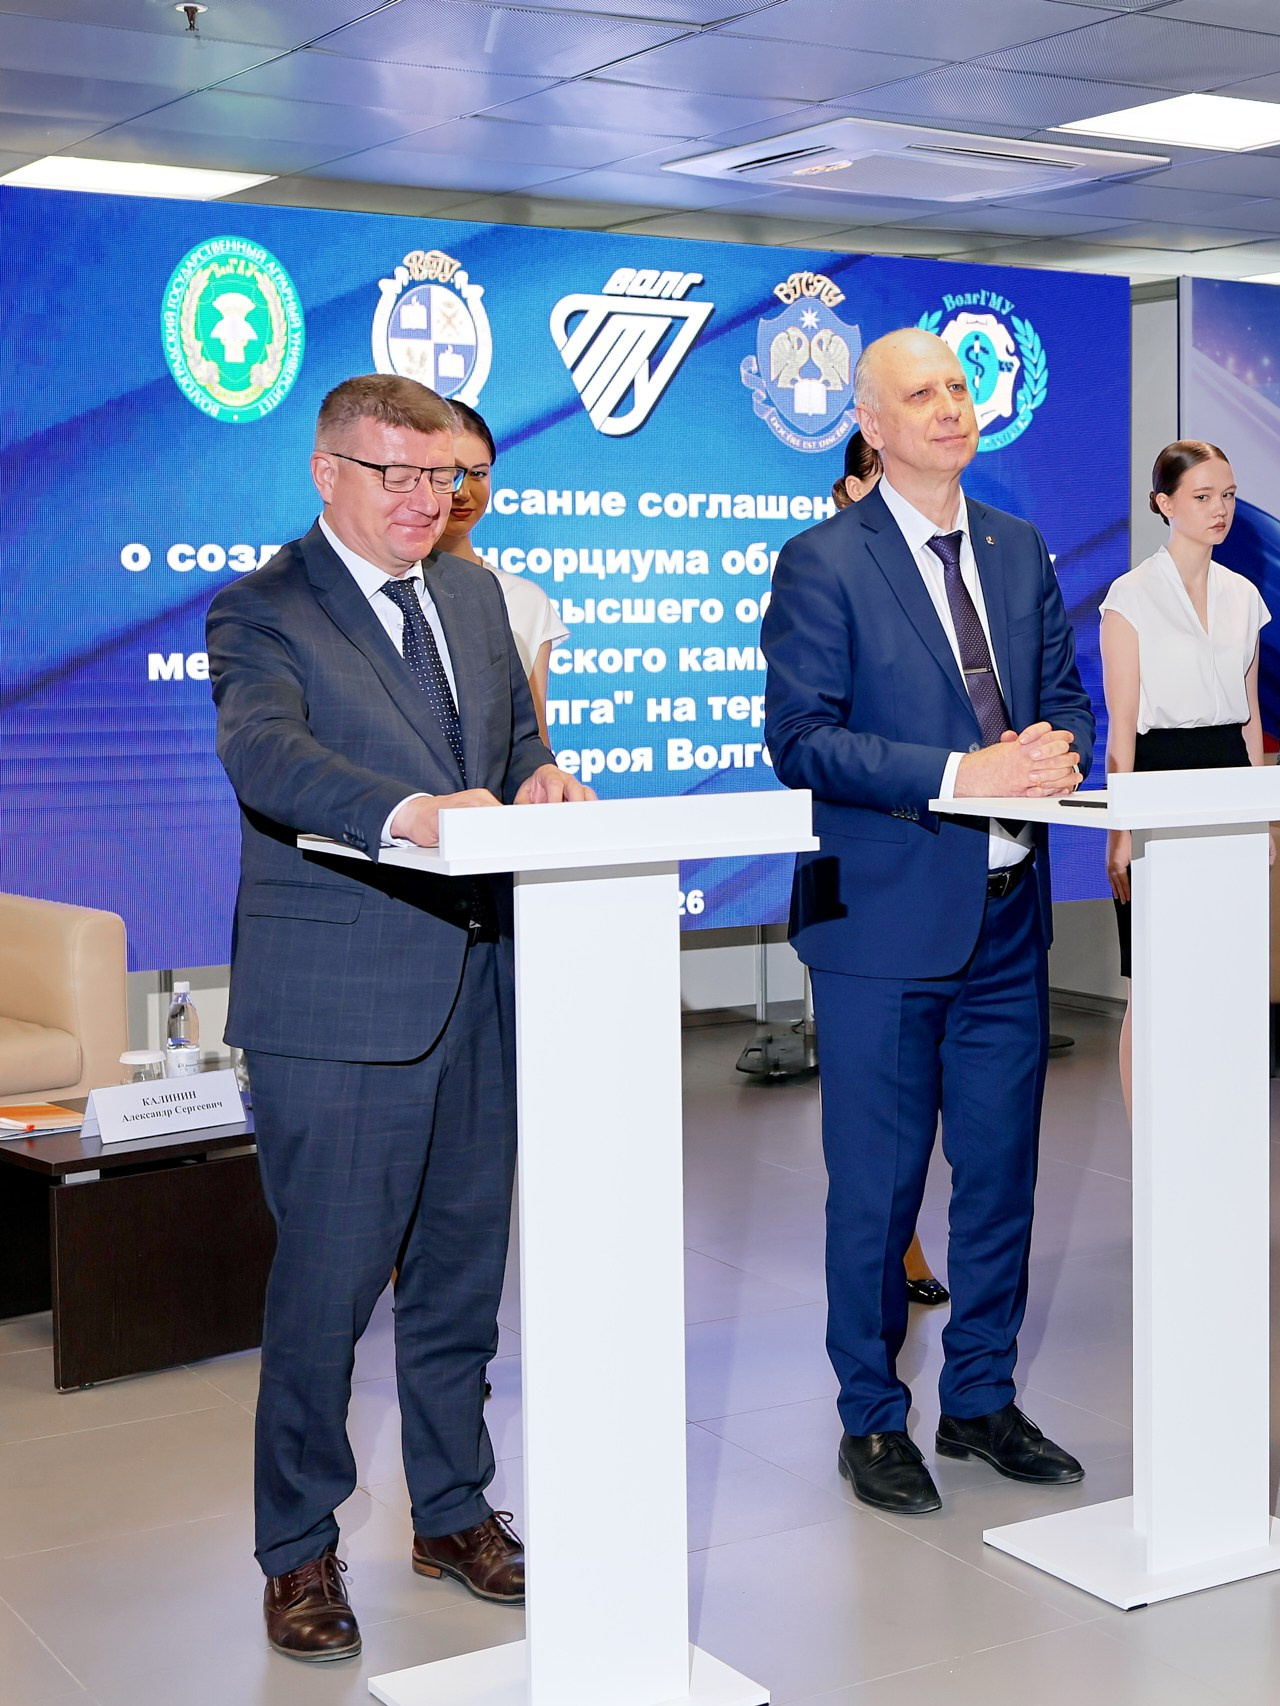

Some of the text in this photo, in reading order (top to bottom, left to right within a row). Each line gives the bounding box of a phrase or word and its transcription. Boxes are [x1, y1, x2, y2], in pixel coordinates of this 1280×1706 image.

[485, 488, 836, 520] сание соглашен
[120, 543, 152, 572] о
[473, 547, 709, 582] нсорциума
[546, 690, 634, 726] лга"
[647, 697, 697, 723] на
[552, 746, 654, 782] ероя
[122, 1100, 223, 1123] Александр Сергеевич
[142, 1090, 197, 1106] КАЛИНИН
